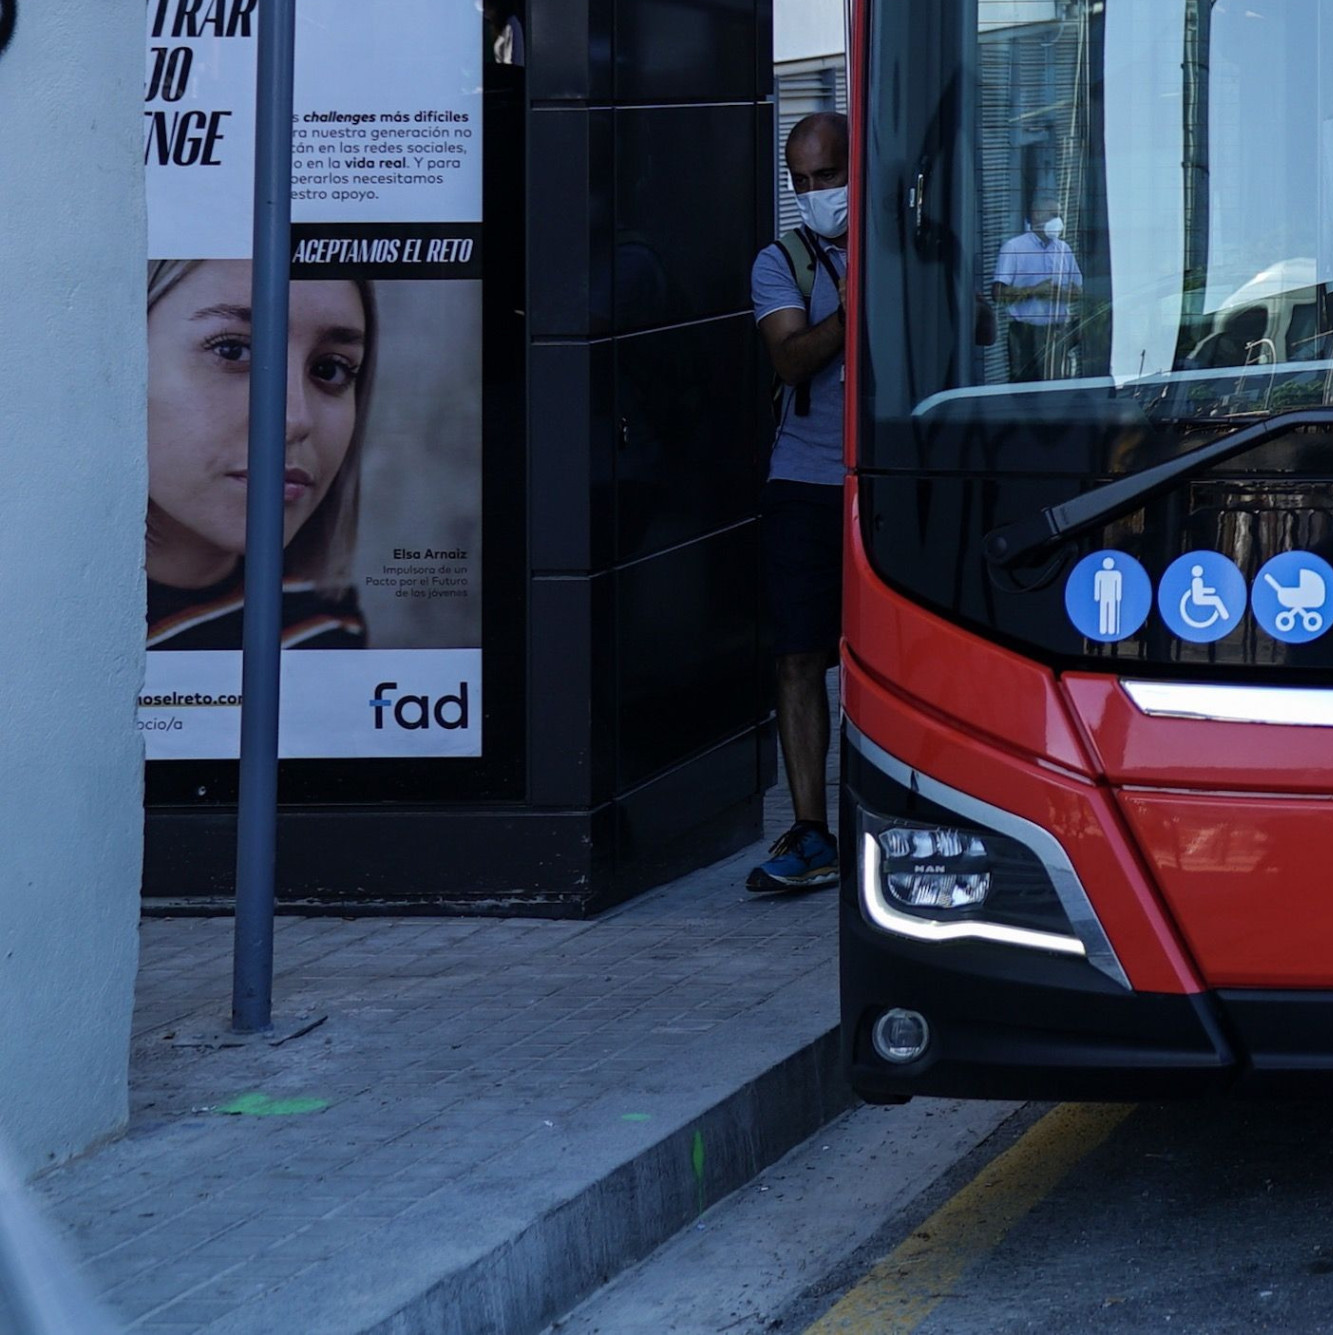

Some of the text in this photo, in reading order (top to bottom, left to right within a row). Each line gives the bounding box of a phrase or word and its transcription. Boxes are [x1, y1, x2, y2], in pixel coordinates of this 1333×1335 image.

[303, 110, 377, 125] challenges
[380, 110, 410, 123] más
[311, 127, 366, 139] nuestra
[370, 126, 450, 141] generación
[454, 128, 472, 138] no
[318, 144, 336, 154] en
[340, 141, 360, 154] las
[363, 141, 403, 154] redes
[406, 141, 467, 155] sociales,
[306, 160, 324, 169] en
[328, 156, 340, 169] la
[344, 156, 375, 169] vida
[379, 156, 410, 169] real.
[413, 157, 424, 169] Y
[427, 159, 461, 172] para
[352, 172, 444, 184] necesitamos
[331, 190, 379, 203] apoyo.
[292, 238, 474, 264] ACEPTAMOS EL RETO
[393, 548, 421, 560] Elsa
[438, 565, 452, 574] de
[365, 576, 398, 586] Pacto
[432, 576, 468, 585] Futuro
[369, 681, 469, 731] fad
[914, 865, 946, 873] MAN
